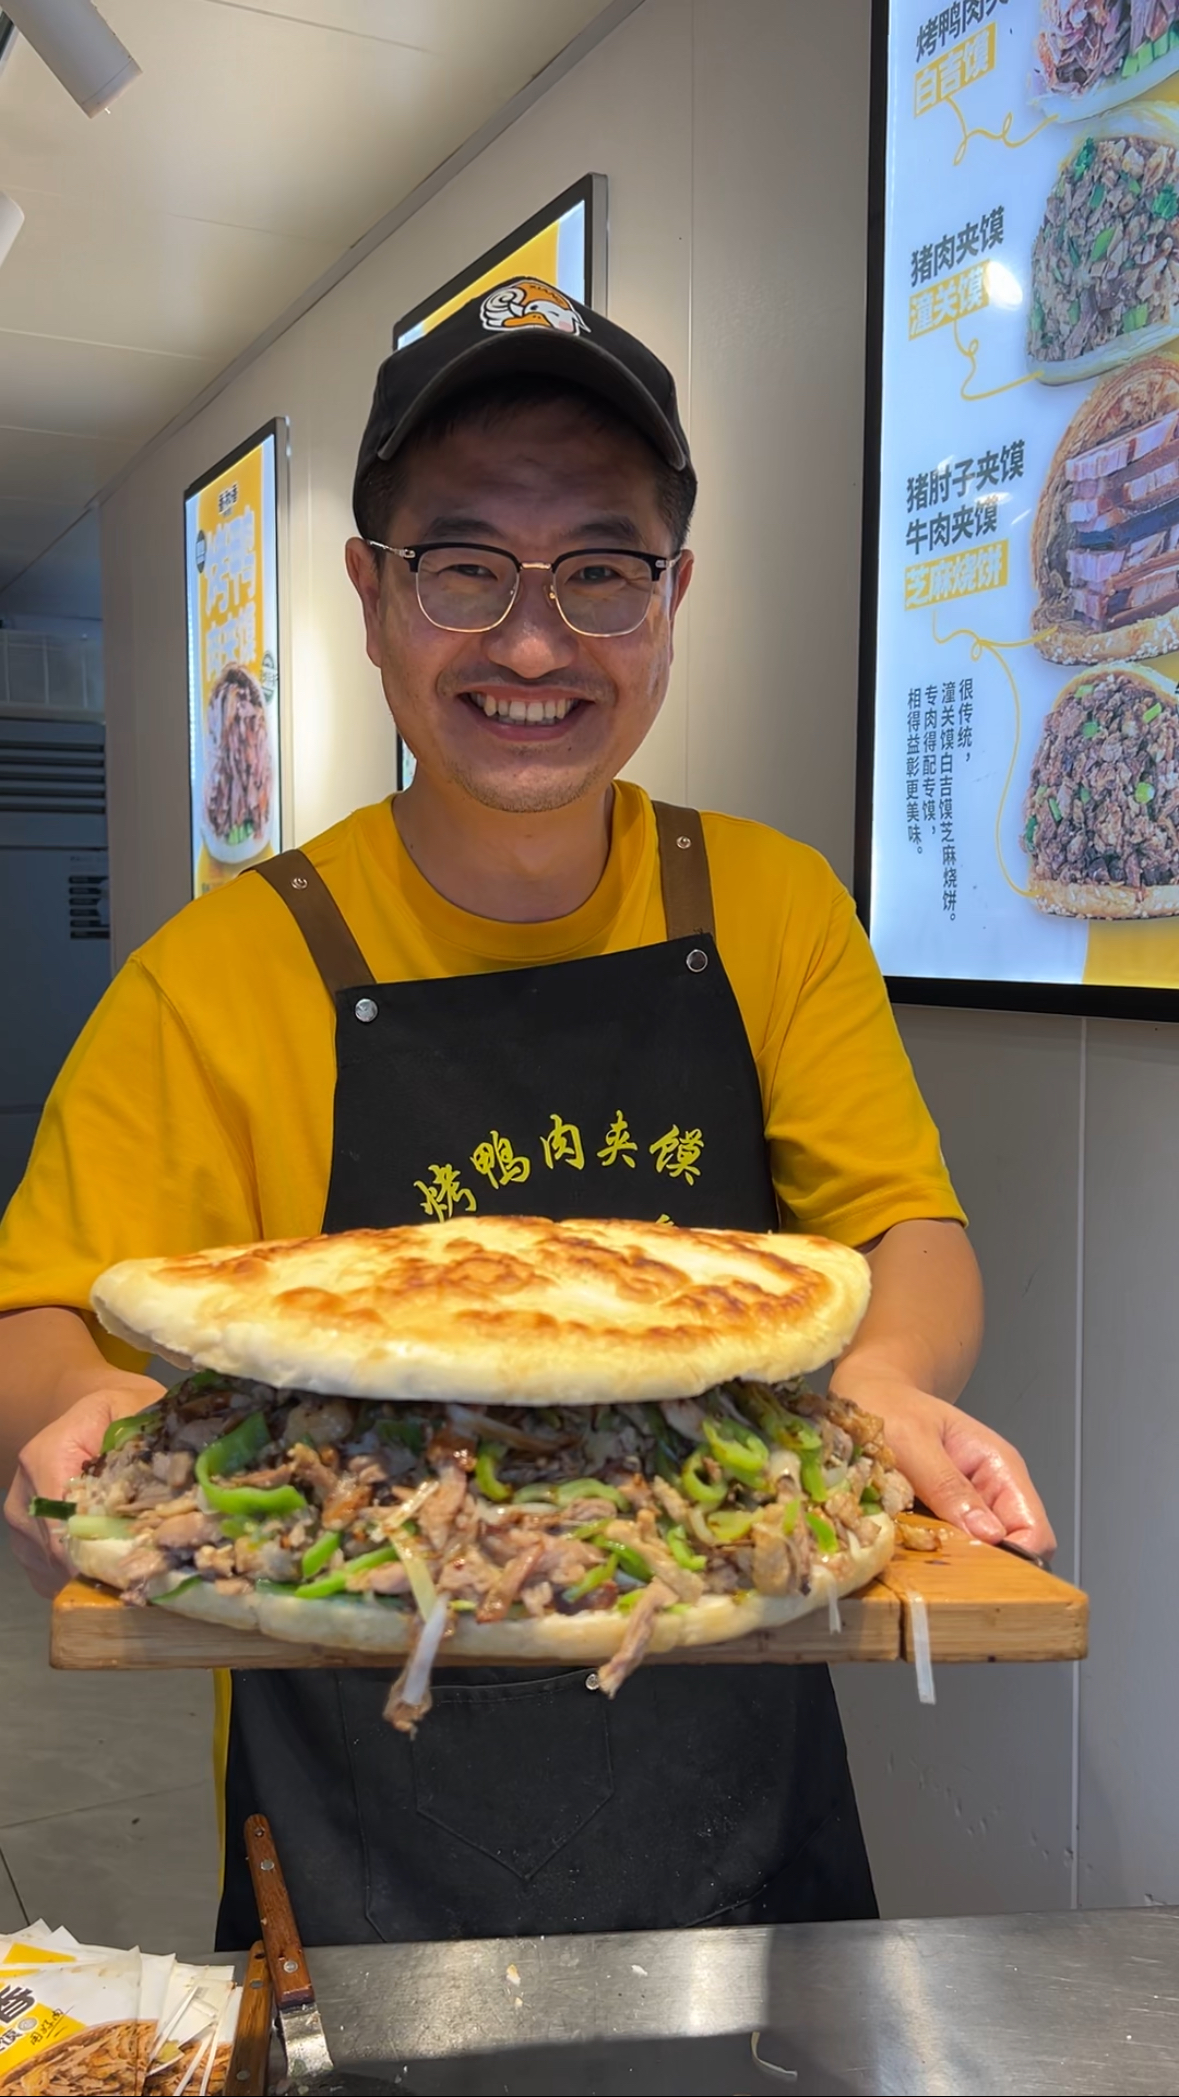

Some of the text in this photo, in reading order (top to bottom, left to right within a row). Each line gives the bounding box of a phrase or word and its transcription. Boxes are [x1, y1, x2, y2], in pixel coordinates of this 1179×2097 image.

[916, 29, 990, 112] 白吉馍
[911, 205, 1004, 287] 猪肉夹馍
[909, 265, 984, 336] 潼关馍
[906, 439, 1025, 513] 猪肘子夹馍
[906, 495, 999, 555] 牛肉夹馍
[906, 543, 1002, 606] 芝麻烧饼
[922, 684, 938, 835] 专肉得配专馍，
[957, 678, 973, 762] 很传统，
[906, 688, 922, 854] 相得益彰更美味。
[939, 681, 957, 921] 潼关馍白吉馍芝麻烧饼。
[413, 1109, 705, 1224] 烤鸭肉夹馍
